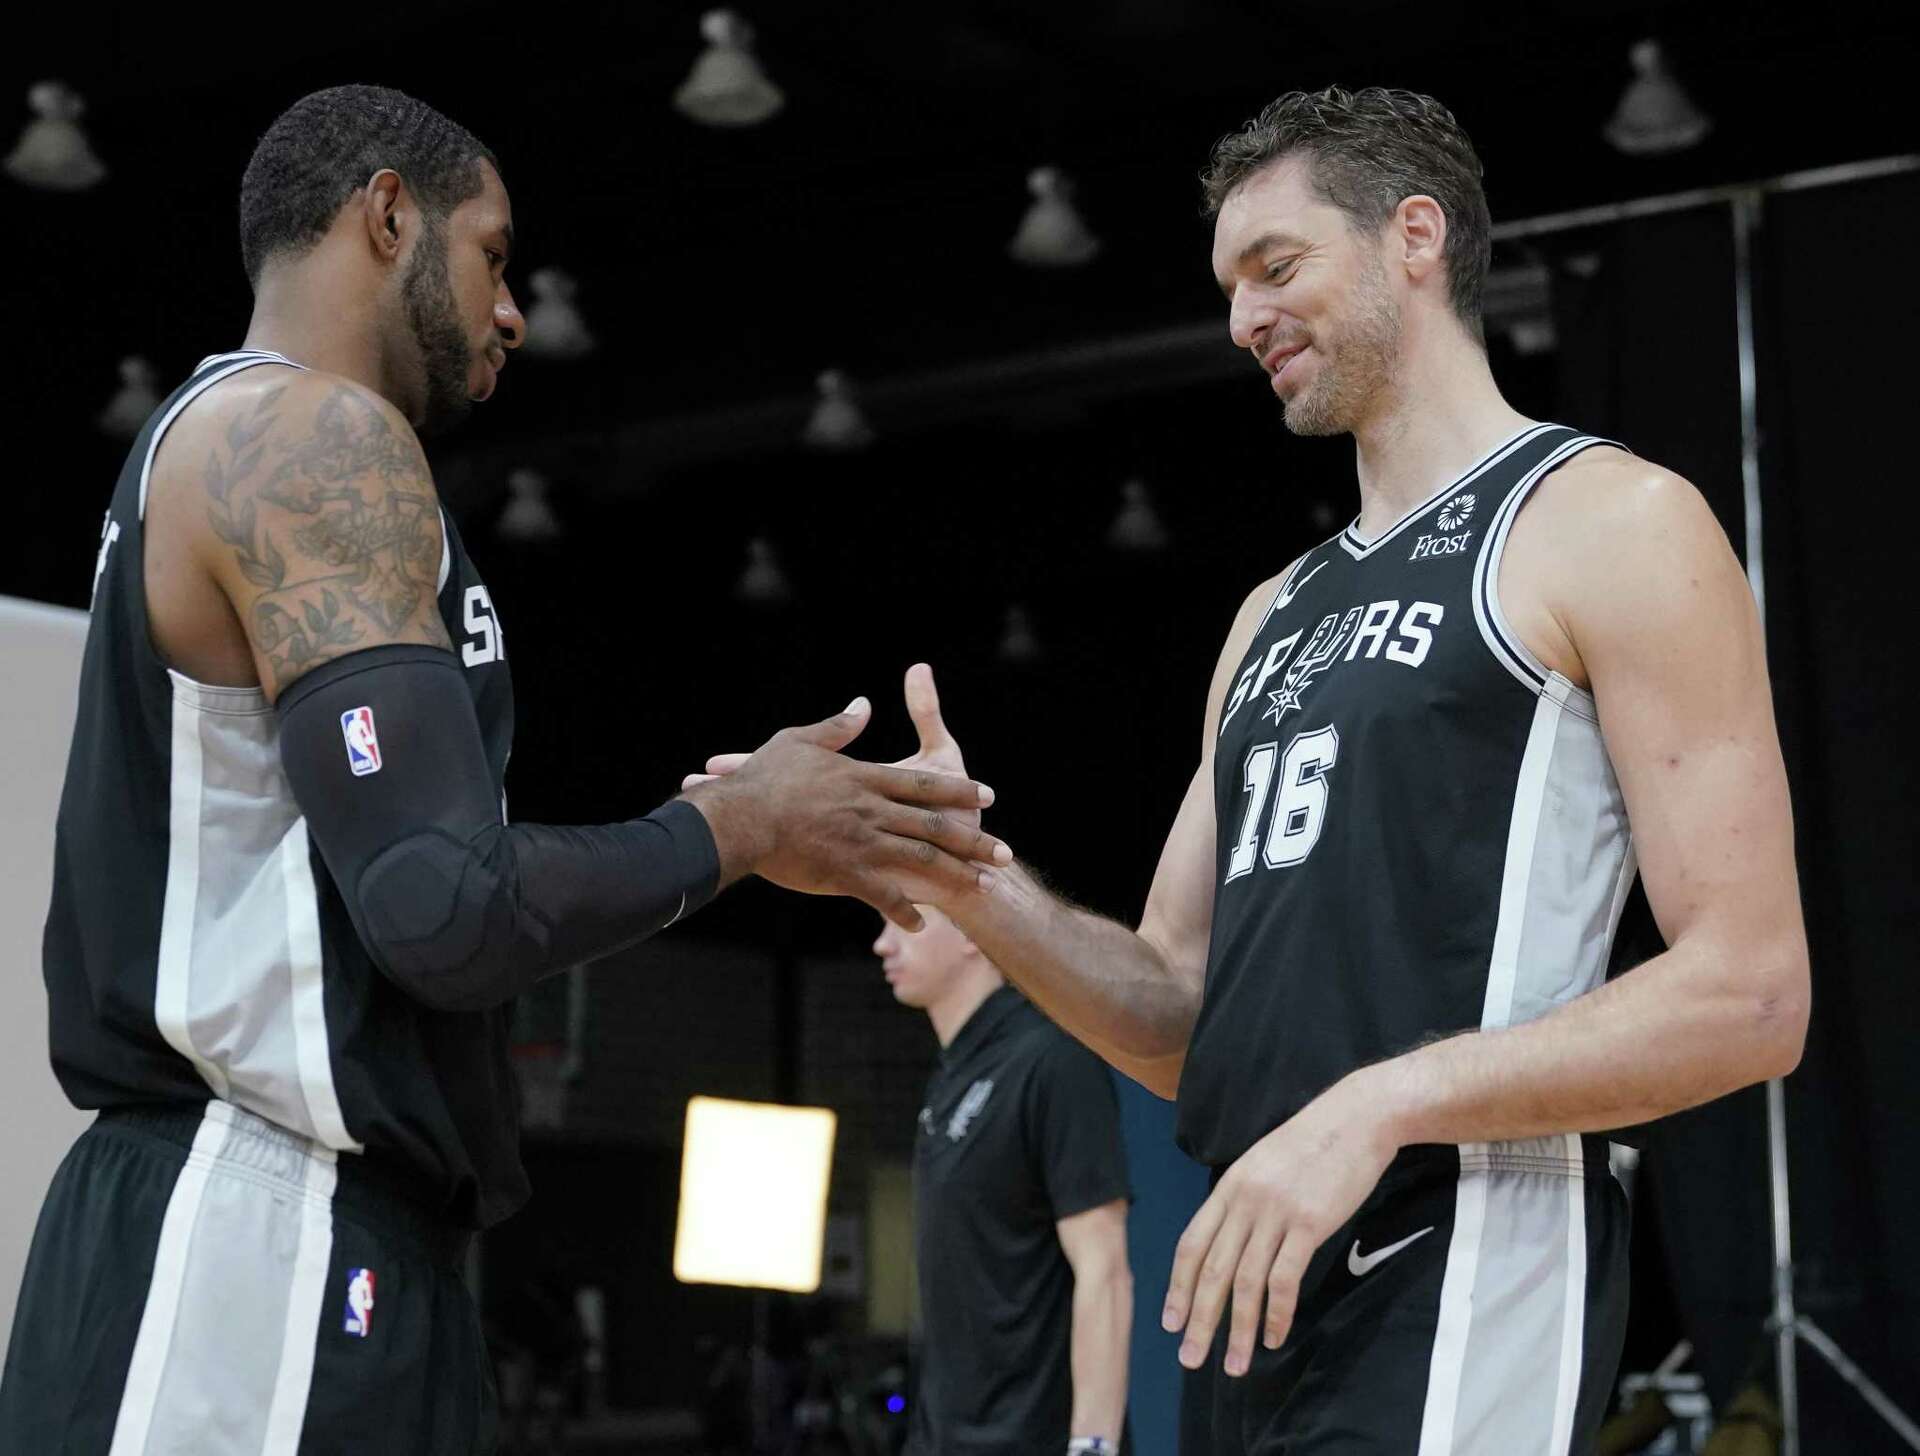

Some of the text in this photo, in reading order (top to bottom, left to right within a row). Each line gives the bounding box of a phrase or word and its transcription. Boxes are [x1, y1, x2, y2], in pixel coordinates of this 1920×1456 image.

[1409, 530, 1471, 560] Frost
[1220, 600, 1444, 736] SPURS
[1225, 723, 1339, 885] 16
